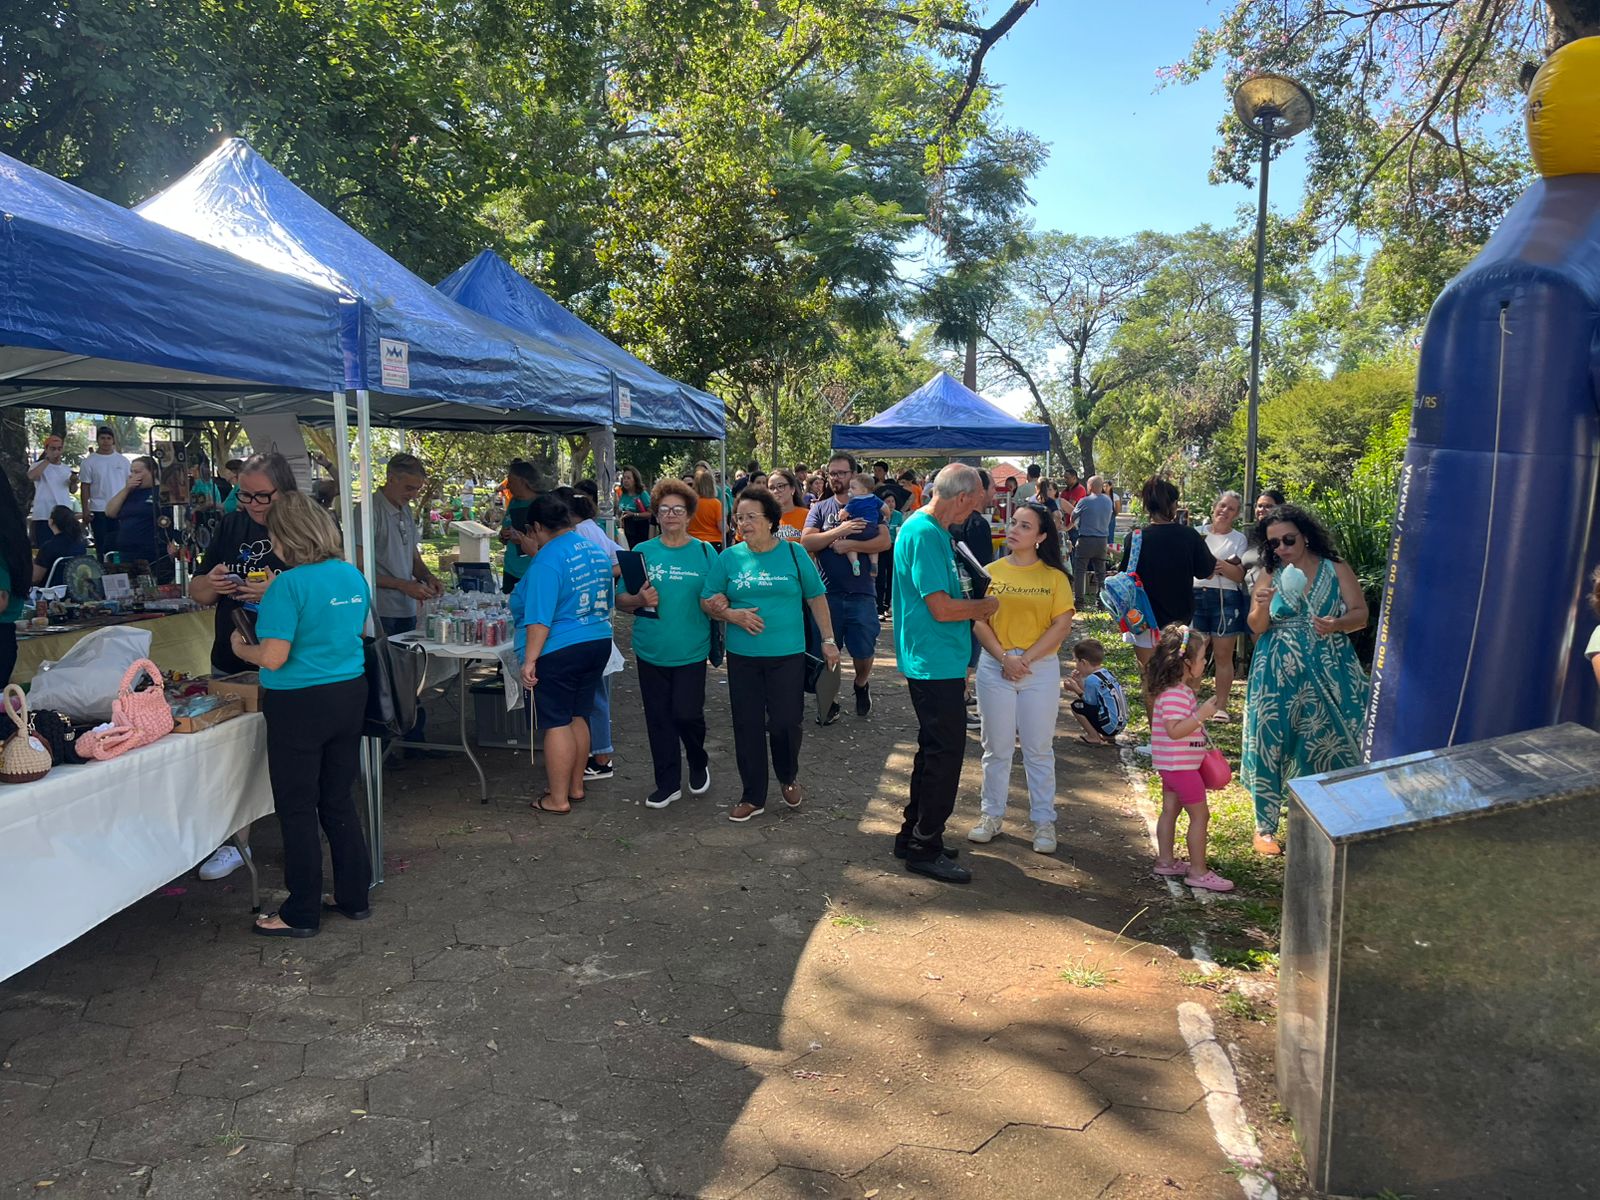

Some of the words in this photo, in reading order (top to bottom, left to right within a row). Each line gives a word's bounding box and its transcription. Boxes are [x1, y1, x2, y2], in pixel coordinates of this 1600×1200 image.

[1392, 534, 1401, 561] SUL
[1389, 564, 1397, 583] DO
[1380, 586, 1395, 643] GRANDE
[1376, 646, 1387, 669] RIO
[1366, 680, 1381, 746] CATARINA
